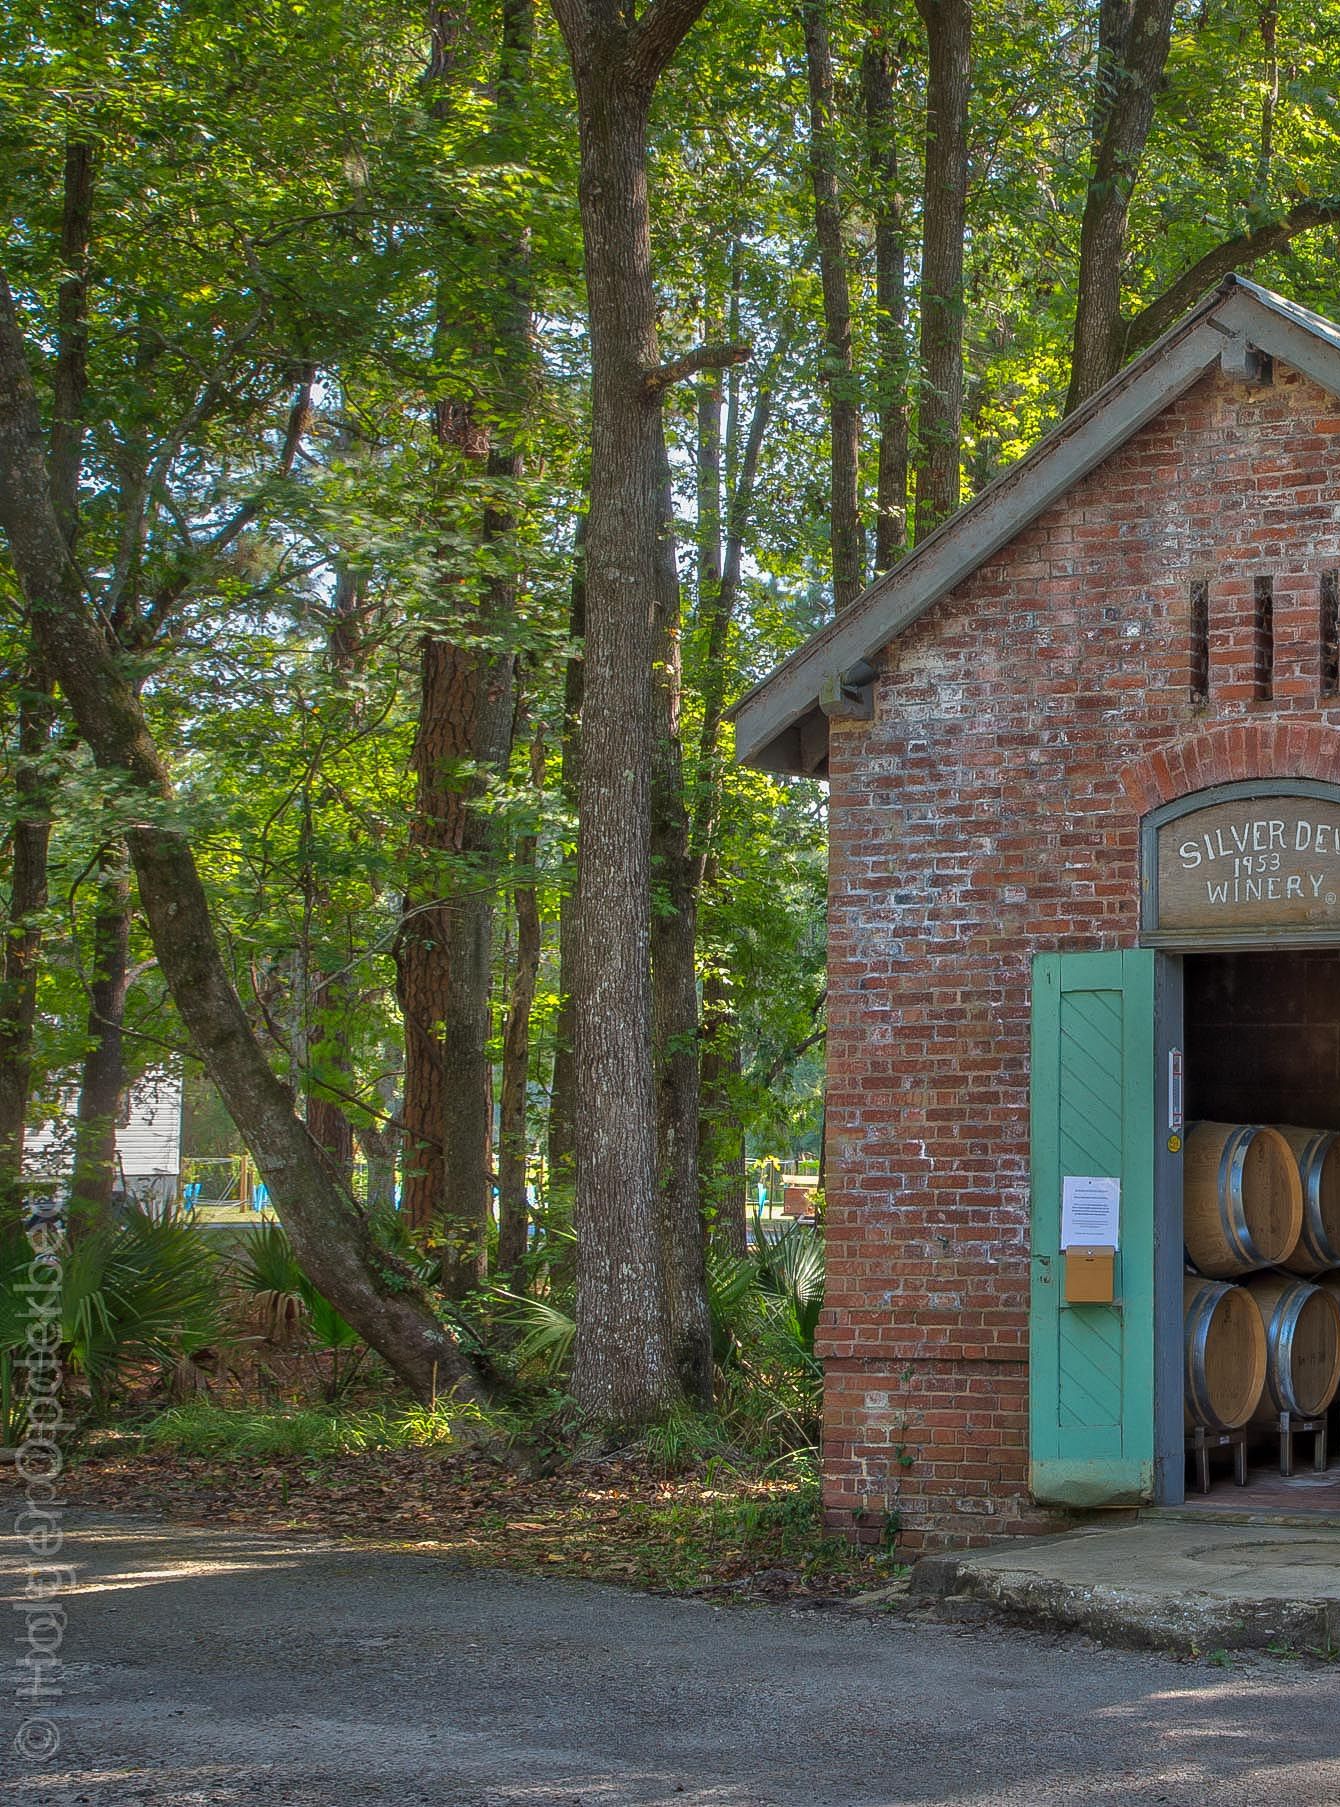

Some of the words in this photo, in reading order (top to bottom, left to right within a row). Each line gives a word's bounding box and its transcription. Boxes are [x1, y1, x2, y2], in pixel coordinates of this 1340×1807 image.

[1179, 820, 1287, 869] SILVER
[1234, 853, 1281, 878] 1953
[1207, 874, 1324, 904] WINERY
